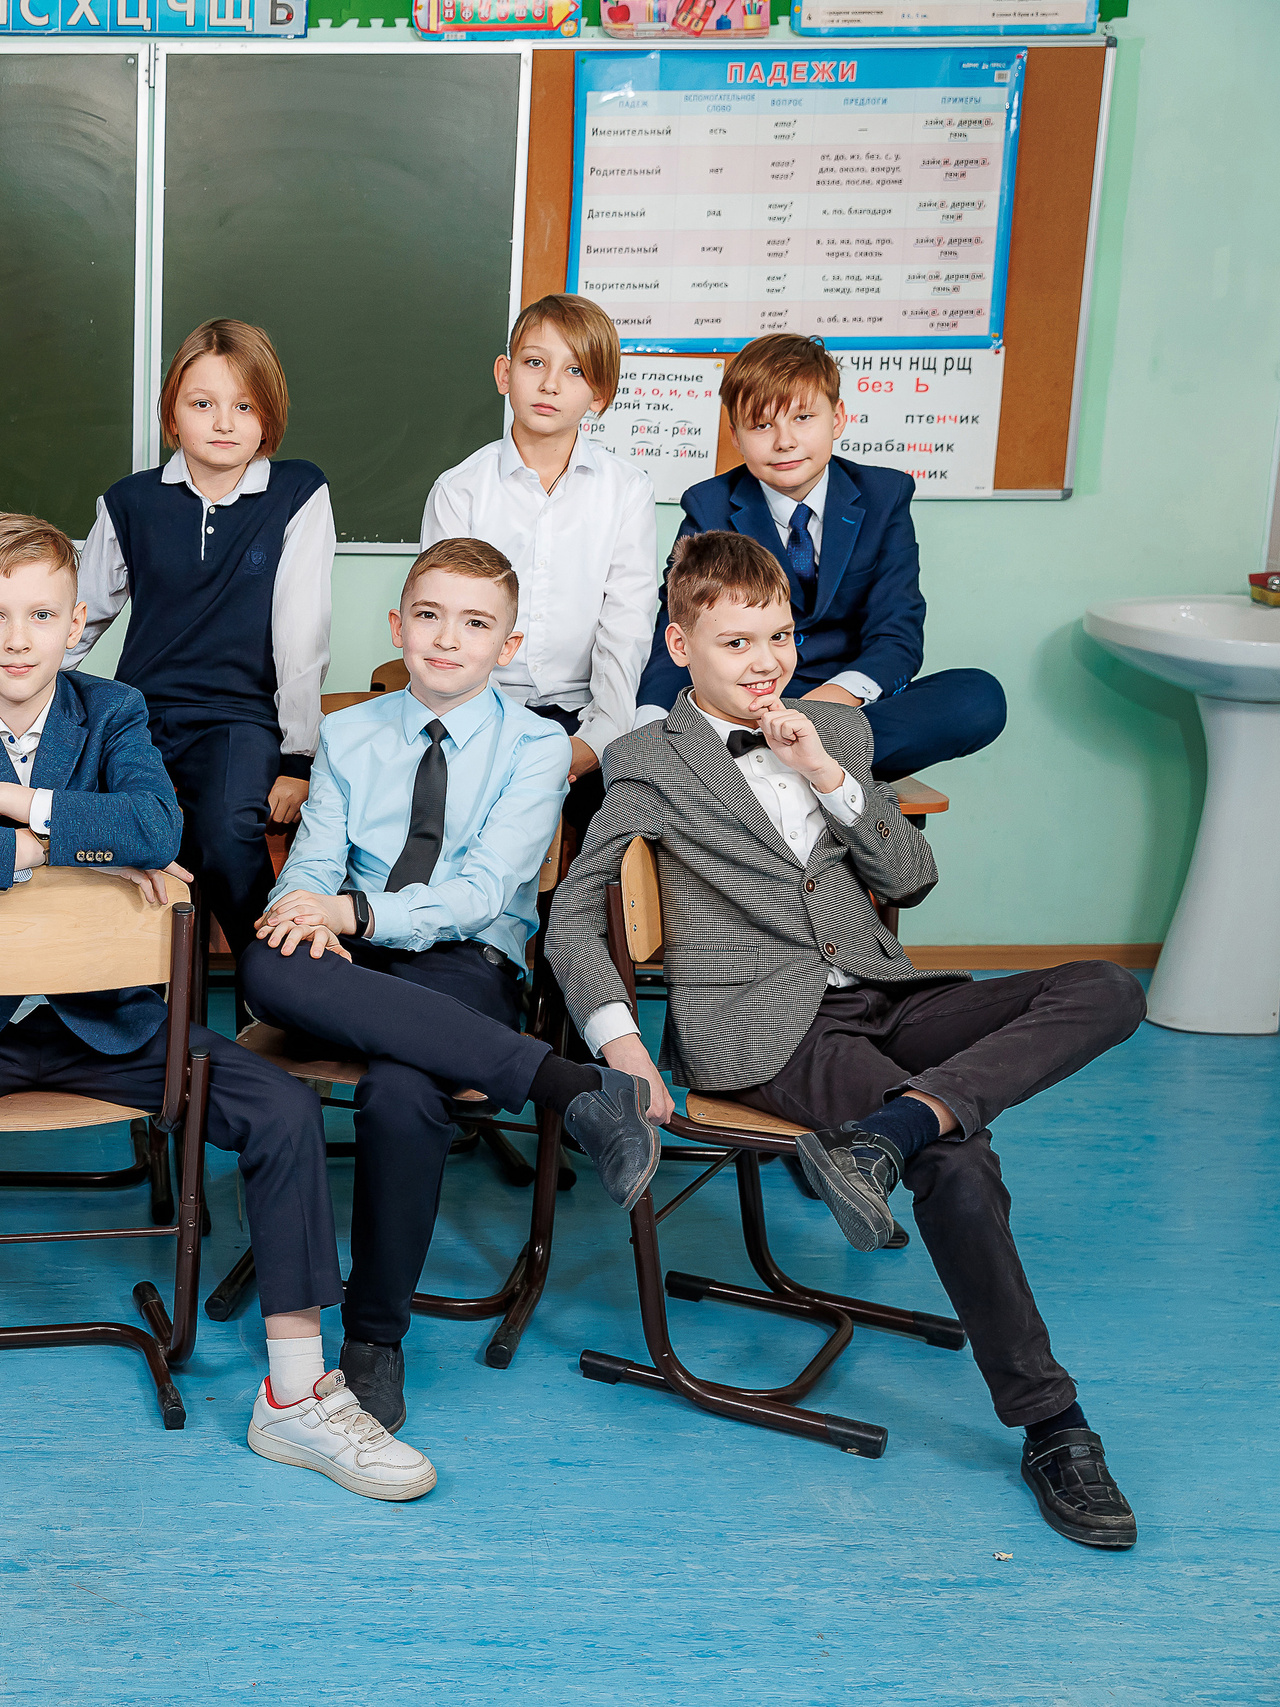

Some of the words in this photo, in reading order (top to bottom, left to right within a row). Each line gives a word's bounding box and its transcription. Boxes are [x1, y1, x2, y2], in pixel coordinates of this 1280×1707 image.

[726, 61, 858, 87] ПАДЕЖИ
[683, 93, 756, 103] ВСПОМОГАТЕЛЬНОЕ
[770, 98, 803, 107] ВОПРОС
[843, 97, 888, 106] ПРЕДЛОГИ
[940, 96, 982, 105] ПРИМЕРЫ
[619, 100, 648, 108] ПАДЕЖ
[707, 105, 732, 113] СЛОВО
[591, 126, 672, 137] Именительный
[709, 127, 727, 135] есть
[589, 165, 661, 177] Родительный
[587, 208, 646, 219] Дательный
[706, 209, 722, 218] рад
[848, 206, 892, 217] благодаря
[586, 243, 659, 254] Винительный
[701, 245, 723, 254] вижу
[584, 279, 660, 291] Творительный
[690, 280, 729, 290] любуюсь
[611, 316, 652, 326] ложный
[694, 316, 722, 326] думаю
[850, 356, 873, 371] чн
[879, 356, 902, 371] нч
[909, 356, 937, 374] нщ
[943, 356, 973, 376] рщ
[641, 371, 703, 382] гласные
[857, 376, 894, 393] без
[914, 377, 930, 393] Ь
[634, 386, 646, 397] а,
[651, 387, 664, 398] о,
[669, 387, 682, 399] и,
[686, 389, 699, 399] е,
[704, 389, 712, 398] я
[645, 402, 673, 411] так.
[905, 413, 980, 424] птенчик
[840, 439, 955, 454] барабанщик
